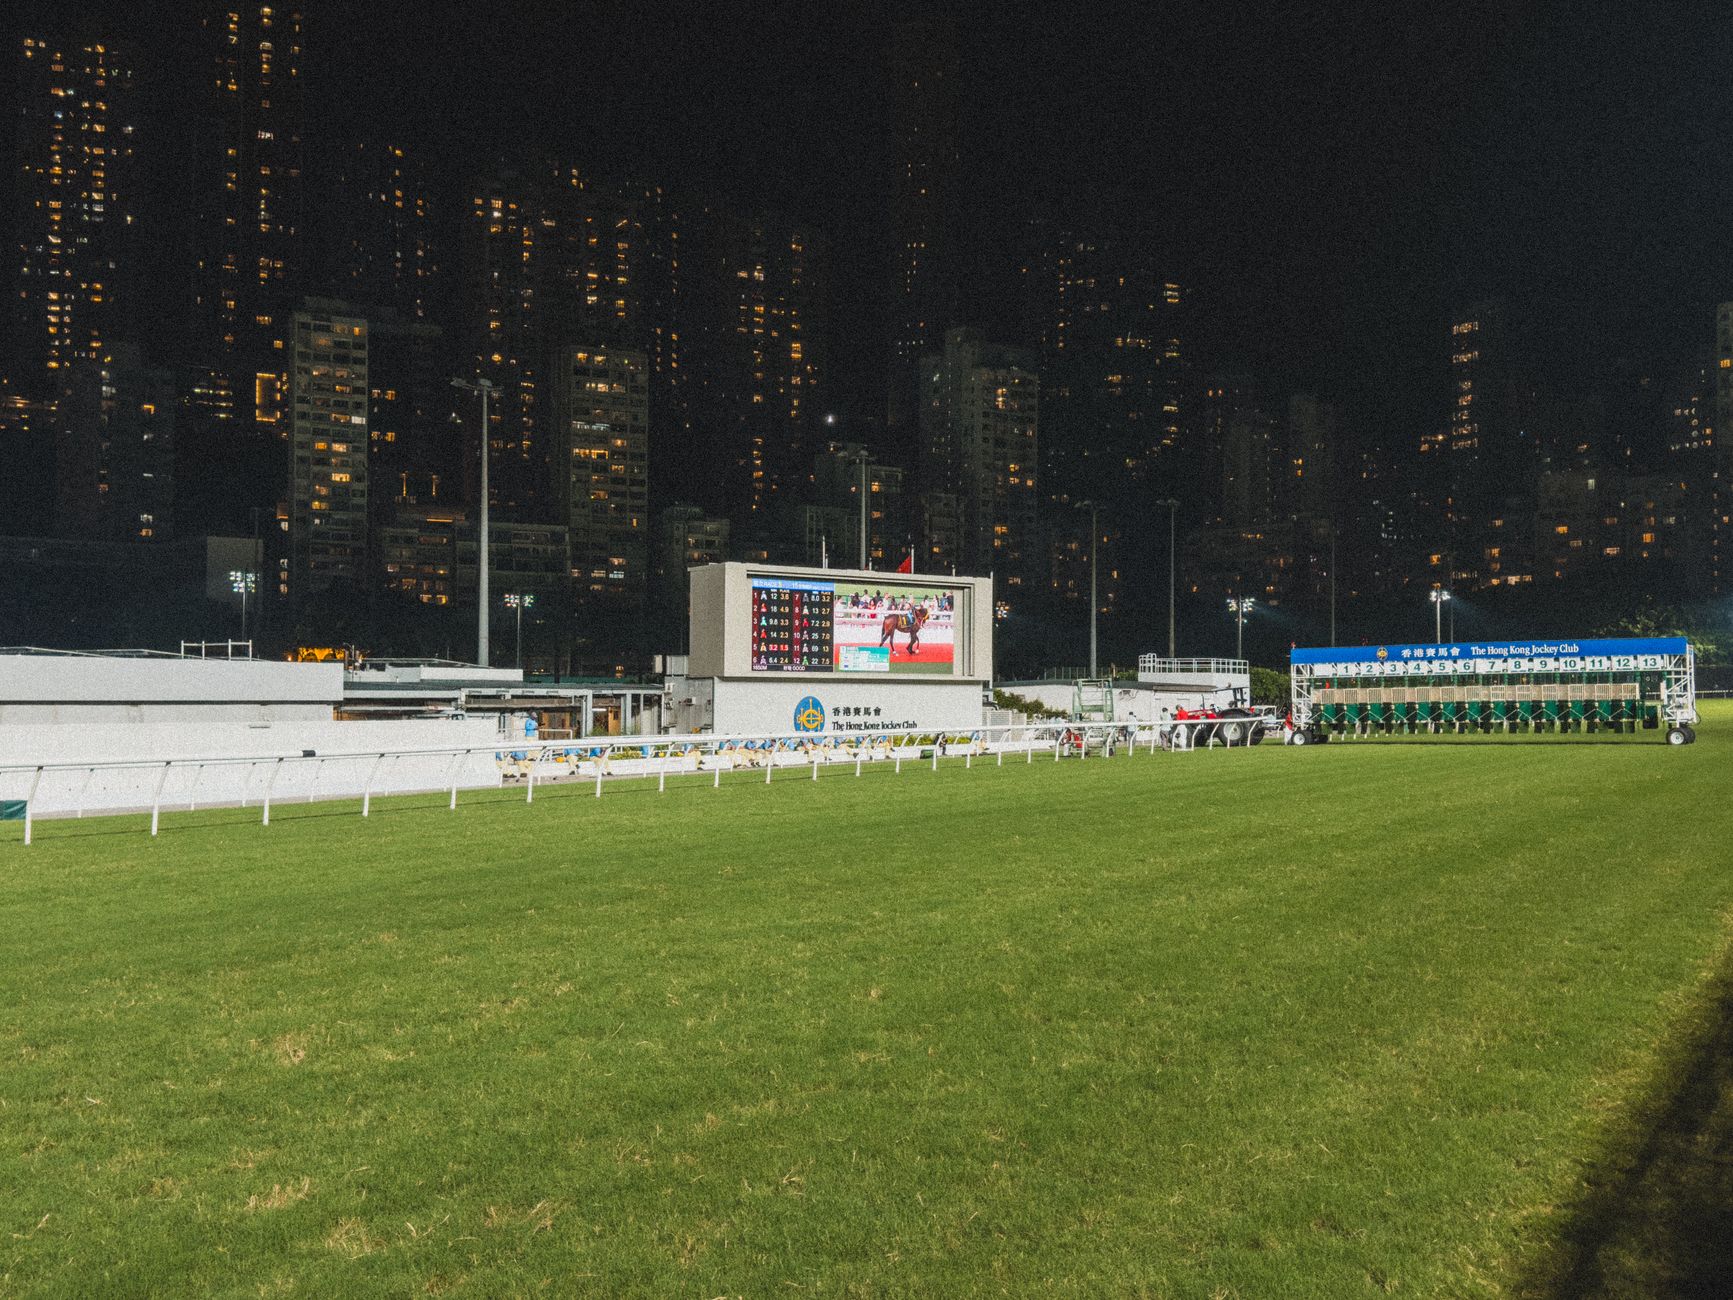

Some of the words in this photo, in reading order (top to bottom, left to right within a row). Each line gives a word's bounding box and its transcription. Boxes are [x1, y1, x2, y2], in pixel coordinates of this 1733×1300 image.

[1401, 646, 1460, 658] 香港賽馬會
[1471, 646, 1487, 655] The
[1487, 646, 1509, 657] Hong
[1509, 645, 1531, 656] Kong
[1530, 644, 1559, 656] Jockey
[1559, 643, 1579, 653] Club
[811, 657, 819, 665] 22
[1463, 661, 1471, 670] 6
[1488, 660, 1496, 670] 7
[1513, 660, 1521, 669] 8
[1539, 659, 1548, 669] 9
[1563, 659, 1577, 668] 10
[1590, 659, 1603, 668] 11
[1615, 658, 1630, 667] 12
[1642, 657, 1658, 667] 13
[1343, 665, 1349, 673] 1
[1366, 664, 1373, 673] 2
[1390, 663, 1397, 672] 3
[1413, 662, 1421, 672] 4
[1439, 662, 1446, 671] 5
[832, 706, 882, 717] 香港賽馬會
[832, 721, 845, 731] The
[846, 721, 862, 731] Hong
[863, 721, 881, 731] Kong
[881, 721, 901, 730] Jockey
[902, 720, 918, 729] Club
